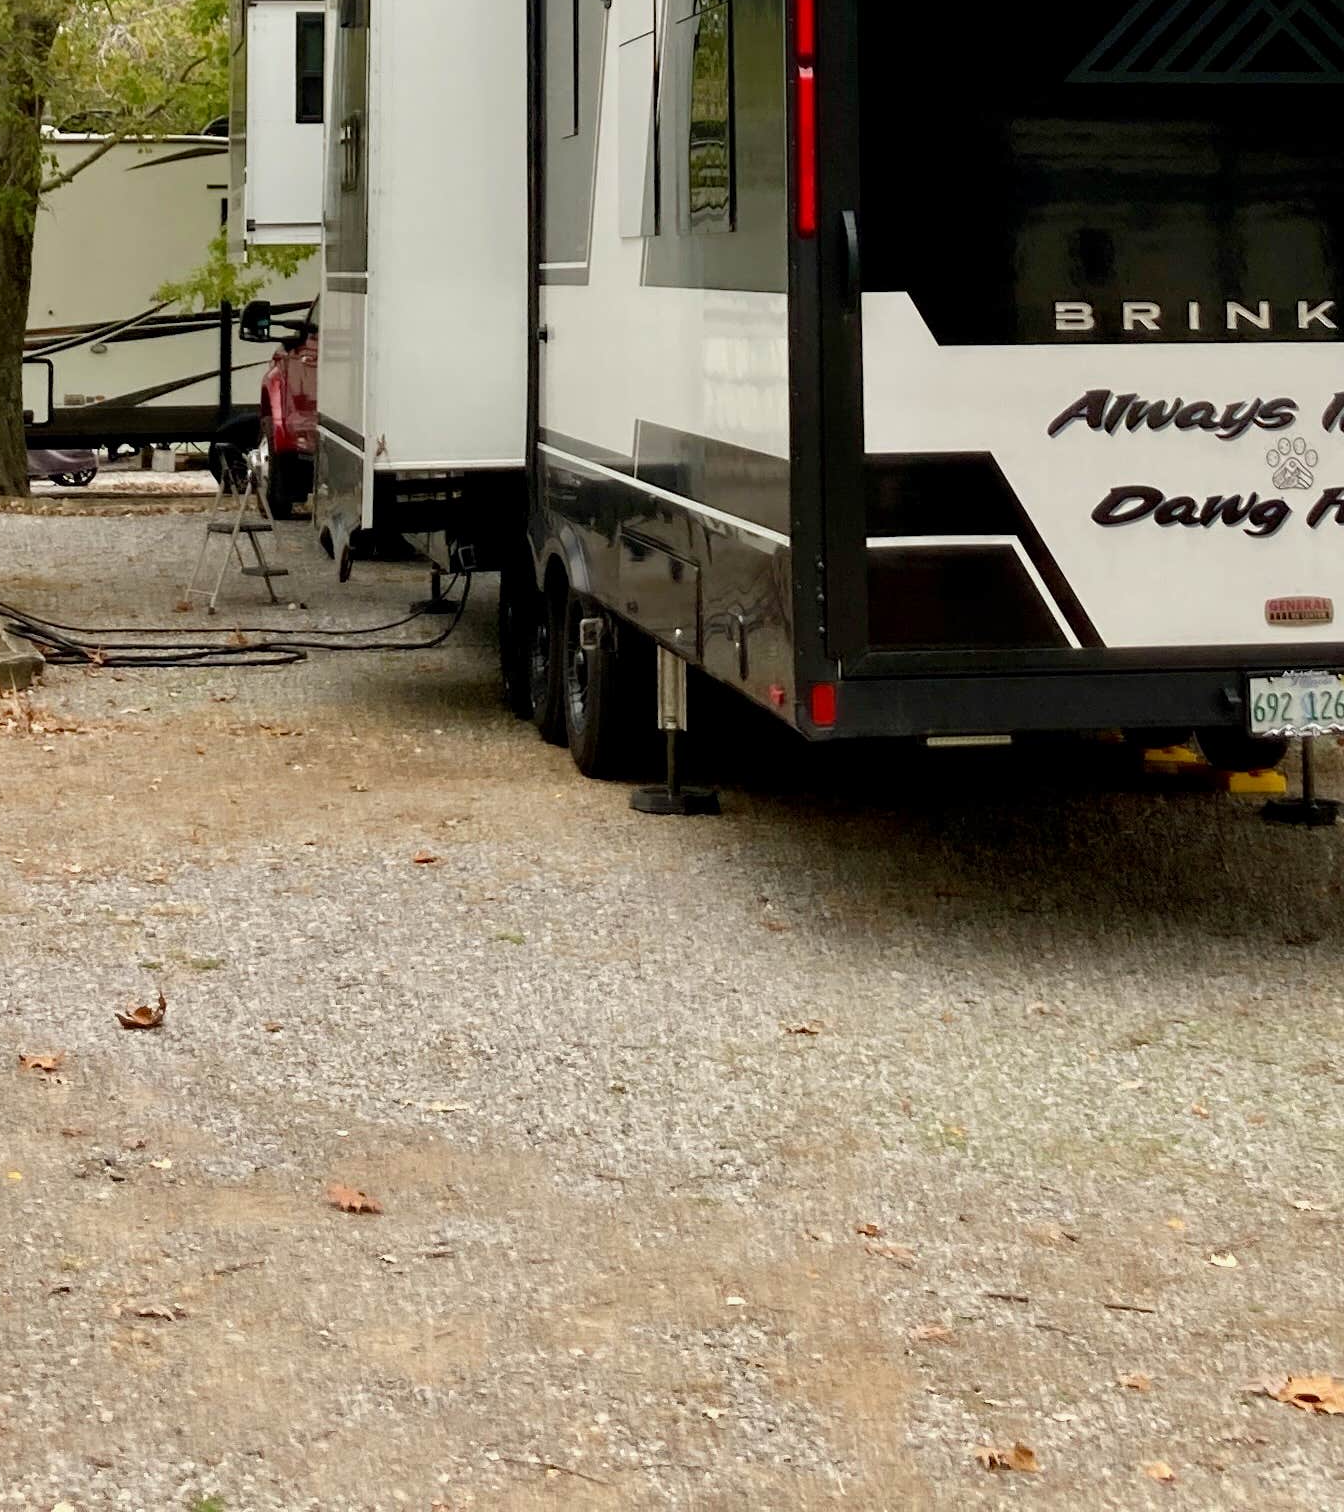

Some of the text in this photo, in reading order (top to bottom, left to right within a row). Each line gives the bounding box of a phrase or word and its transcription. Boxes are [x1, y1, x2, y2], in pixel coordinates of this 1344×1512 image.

[1047, 388, 1298, 441] Always
[1091, 485, 1293, 538] Dawg
[1269, 599, 1330, 610] GENERAL
[1253, 692, 1294, 723] 692
